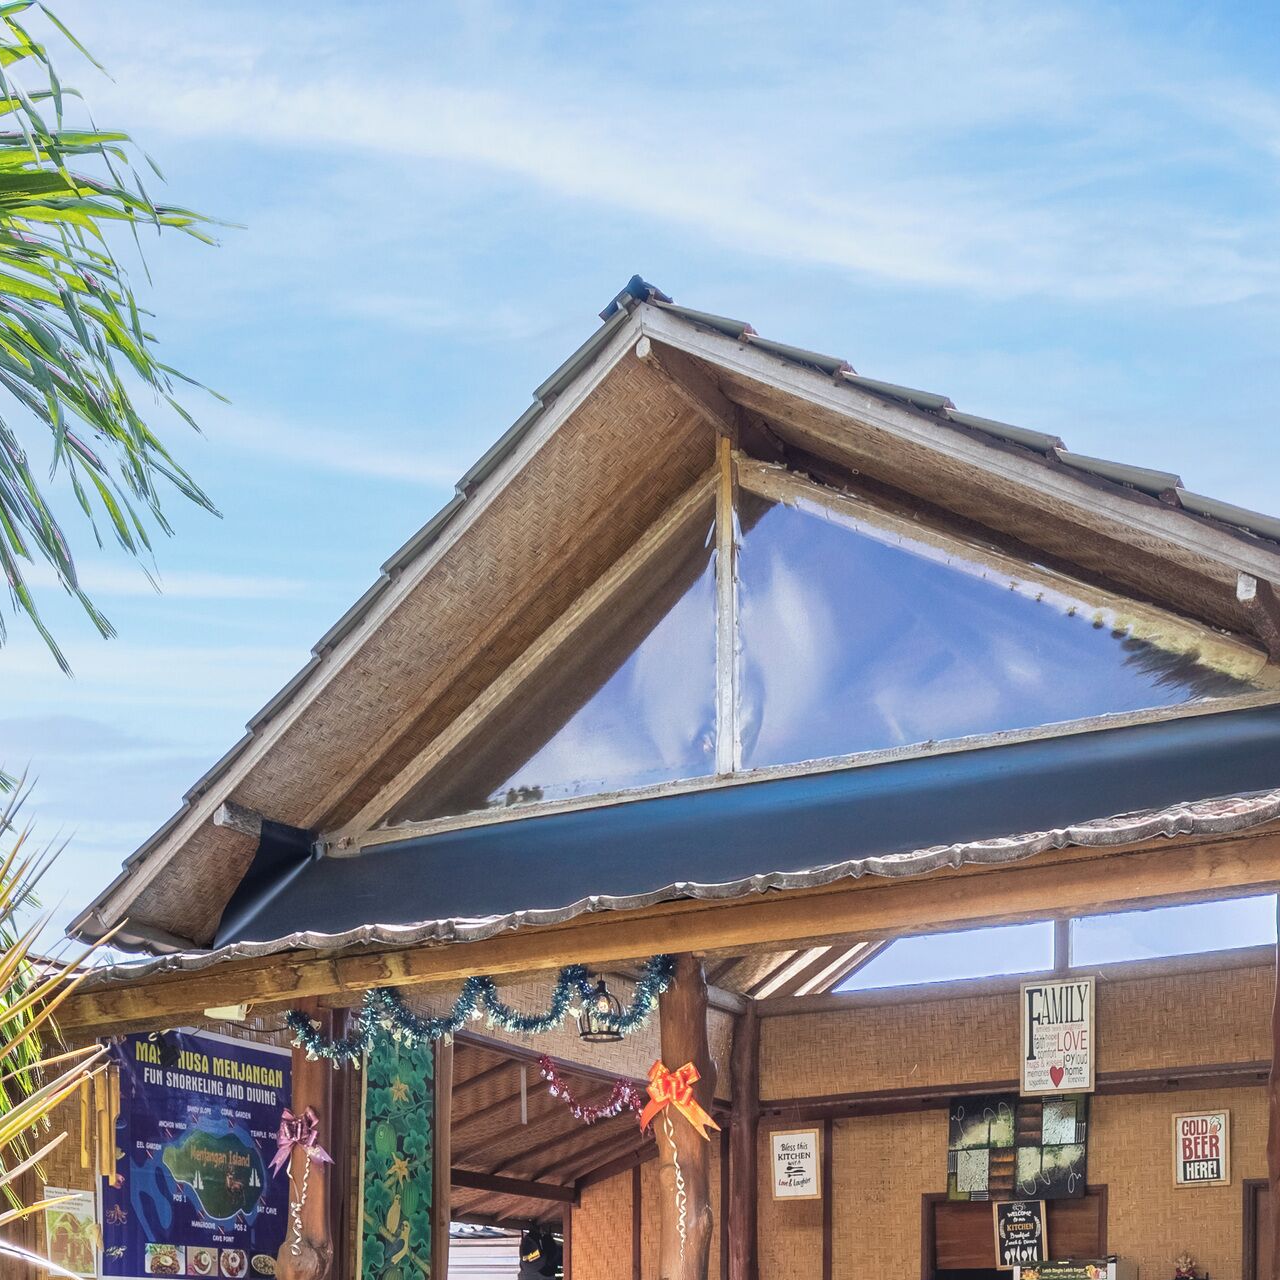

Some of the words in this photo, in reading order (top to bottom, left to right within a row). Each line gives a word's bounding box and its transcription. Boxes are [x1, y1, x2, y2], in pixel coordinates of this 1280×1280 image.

[1026, 984, 1088, 1060] FAMILY
[1057, 1030, 1088, 1052] LOVE
[1063, 1051, 1075, 1068] joy
[178, 1050, 209, 1074] NUSA
[213, 1057, 283, 1088] MENJANGAN
[1065, 1066, 1083, 1076] home
[144, 1067, 163, 1085] FUN
[166, 1072, 223, 1096] SNORKELING
[226, 1083, 244, 1100] AND
[246, 1087, 276, 1106] DIVING
[220, 1108, 234, 1117] CORAL
[235, 1110, 252, 1119] GARDEN
[250, 1130, 267, 1139] TEMPLE
[1181, 1119, 1208, 1136] COLD
[136, 1141, 145, 1149] EEL
[781, 1143, 796, 1151] Bless
[797, 1142, 808, 1150] this
[1182, 1135, 1220, 1160] BEER
[190, 1145, 227, 1168] Menjangan
[229, 1150, 250, 1167] Island
[777, 1152, 811, 1160] KITCHEN
[1186, 1161, 1218, 1179] HERE!
[793, 1177, 811, 1187] Laughter
[1007, 1223, 1034, 1231] KITCHEN
